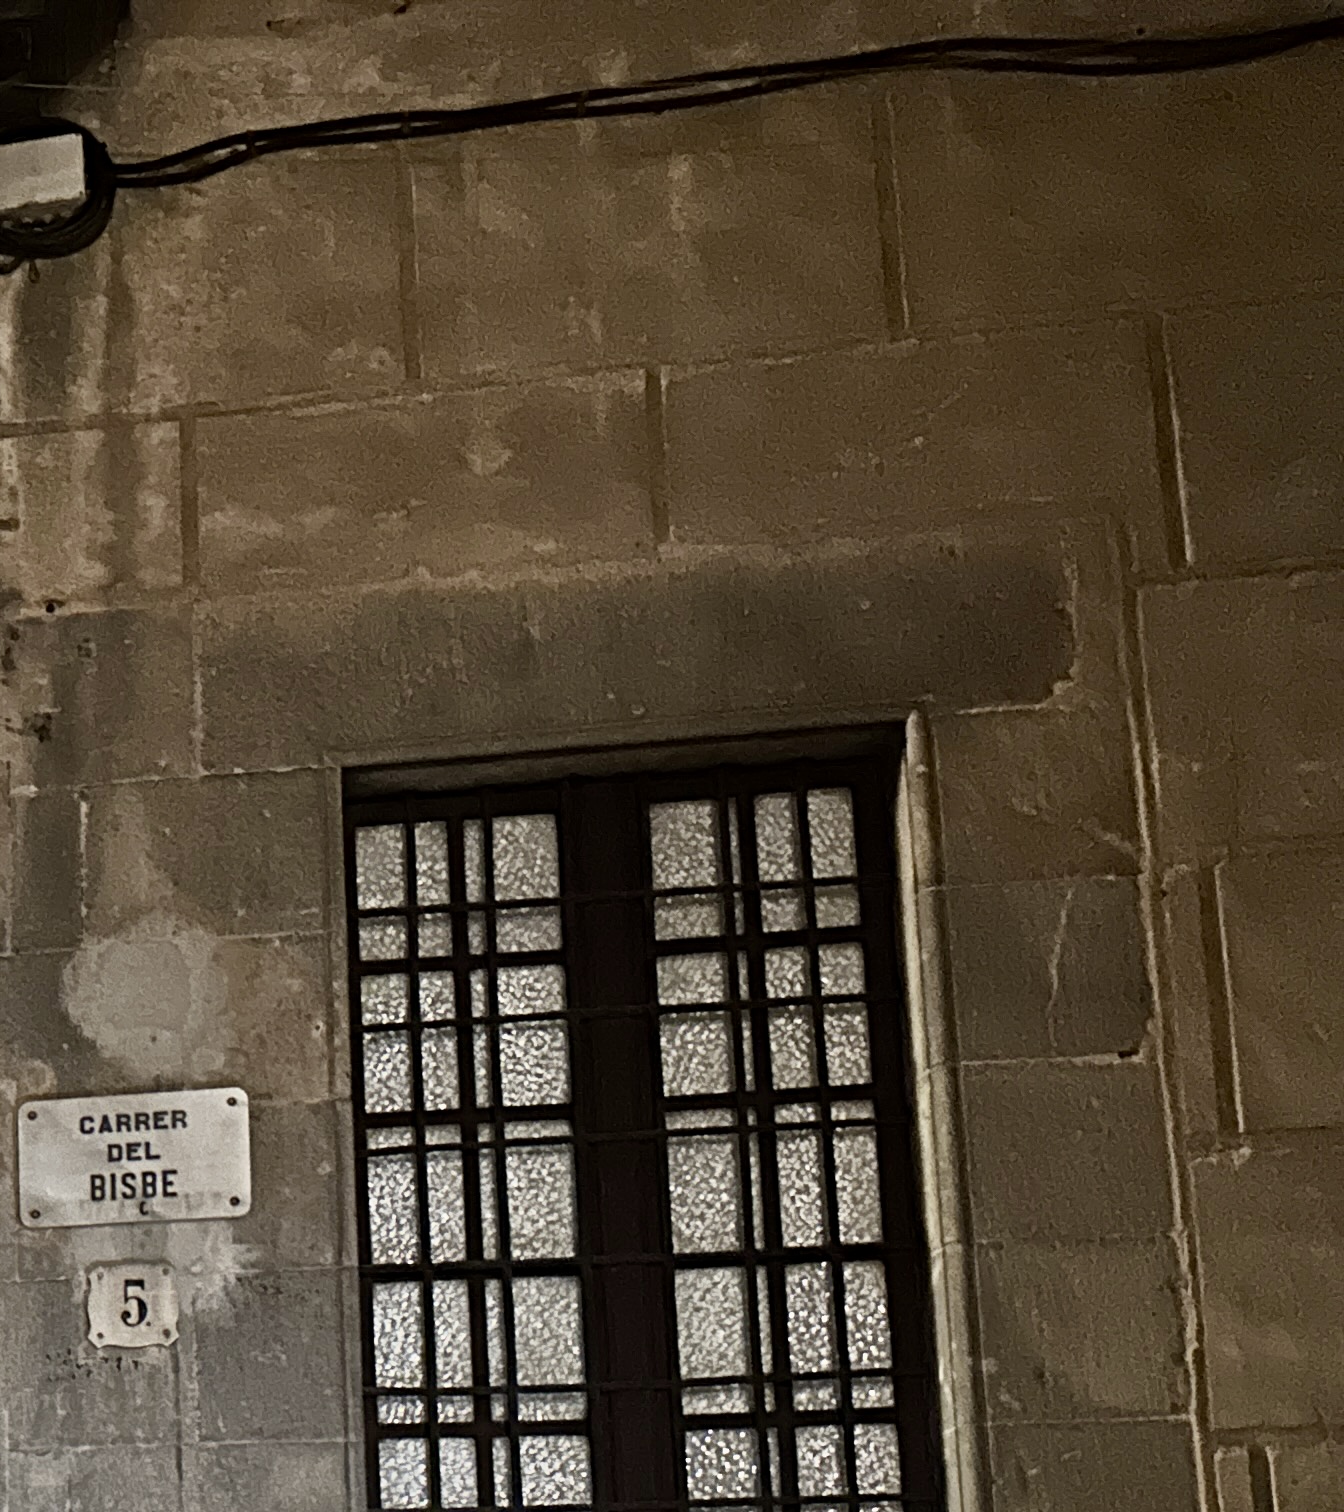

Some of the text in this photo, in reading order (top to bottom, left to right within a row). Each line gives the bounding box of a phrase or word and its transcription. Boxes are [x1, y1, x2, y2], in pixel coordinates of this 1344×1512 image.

[79, 1109, 188, 1135] CARRER
[107, 1141, 161, 1163] DEL
[89, 1169, 179, 1202] BISBE
